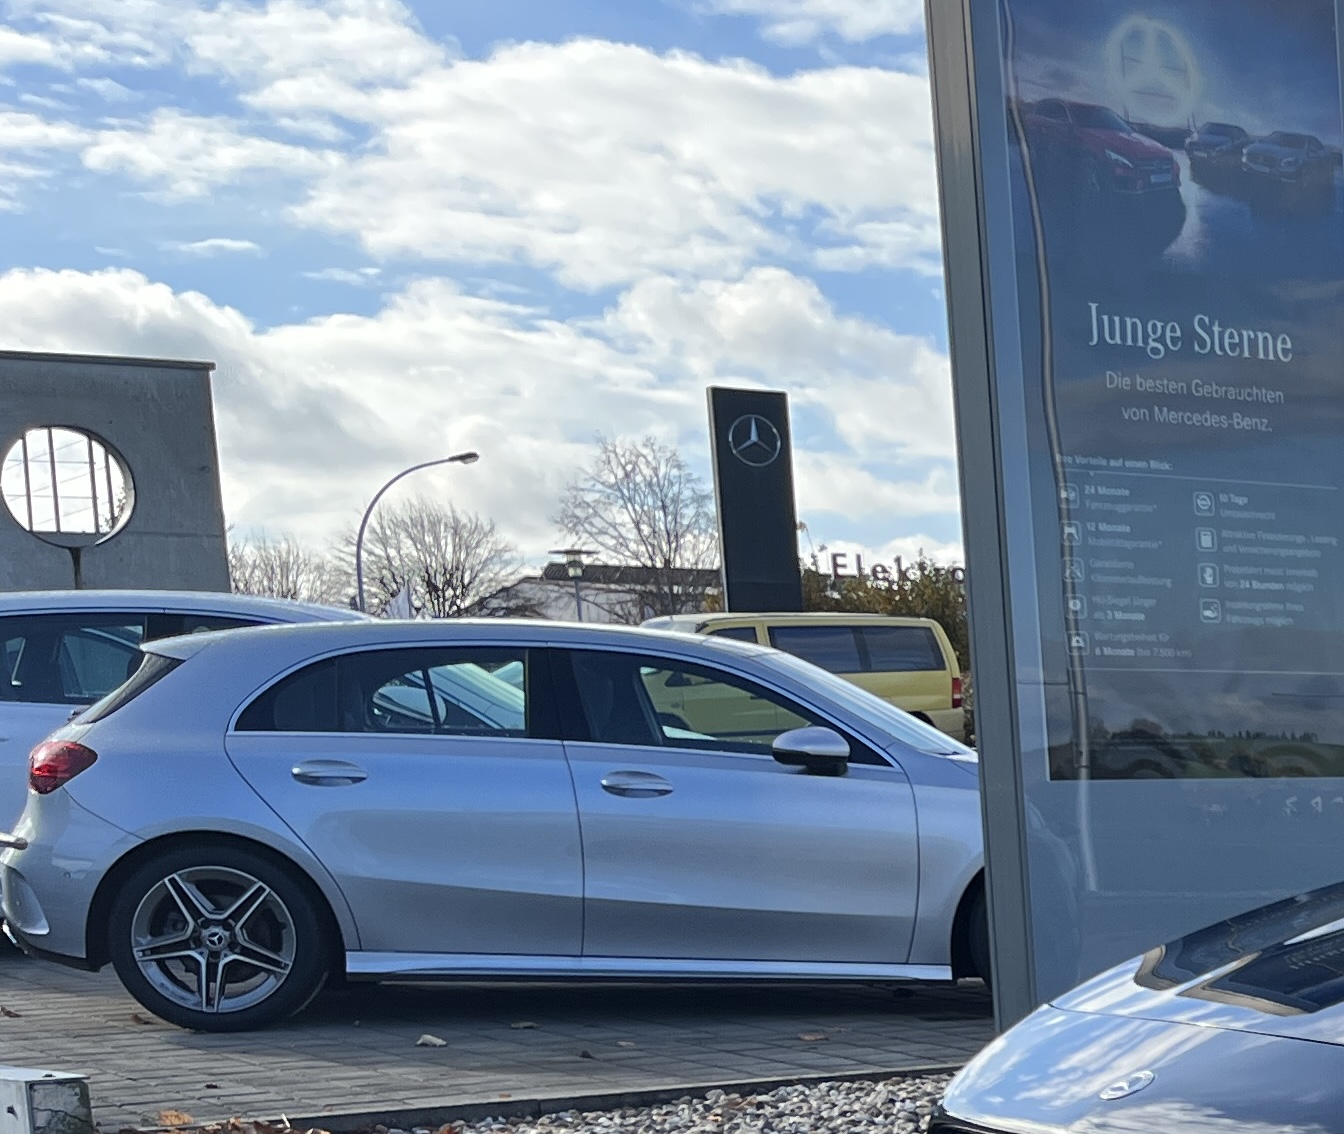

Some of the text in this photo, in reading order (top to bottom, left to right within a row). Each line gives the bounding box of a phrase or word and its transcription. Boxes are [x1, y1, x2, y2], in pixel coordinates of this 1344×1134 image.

[1087, 301, 1293, 362] Junge Sterne
[1105, 370, 1285, 404] Die besten Gebrauchten
[1121, 404, 1273, 433] von Mercedes-Benz.
